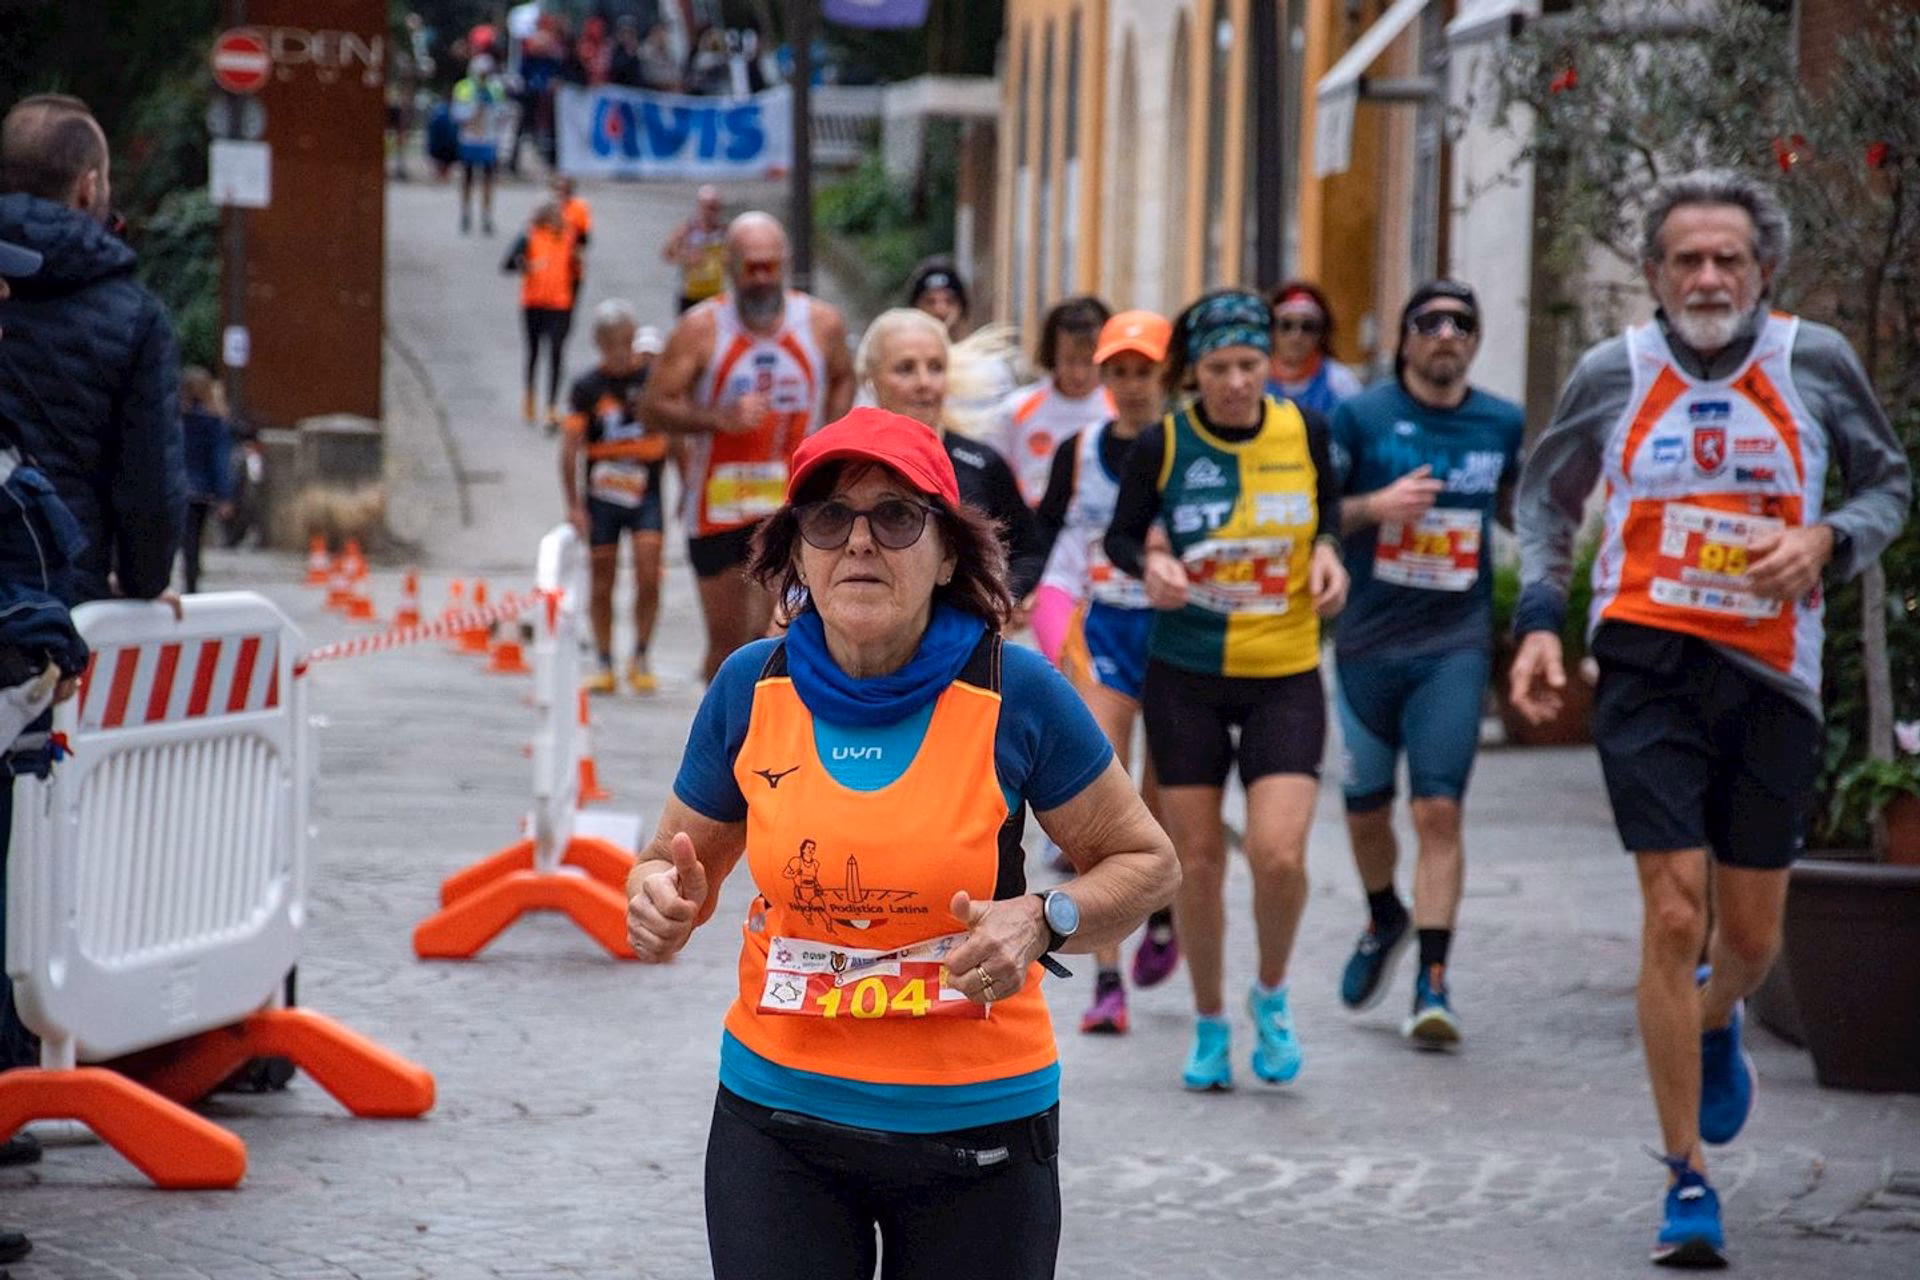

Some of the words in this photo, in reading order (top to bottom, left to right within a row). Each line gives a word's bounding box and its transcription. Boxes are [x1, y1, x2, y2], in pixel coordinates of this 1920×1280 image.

[592, 98, 765, 160] AVIS
[832, 746, 883, 760] UYN
[829, 903, 884, 915] Podistica
[889, 905, 929, 915] Latina
[816, 977, 931, 1018] 104
